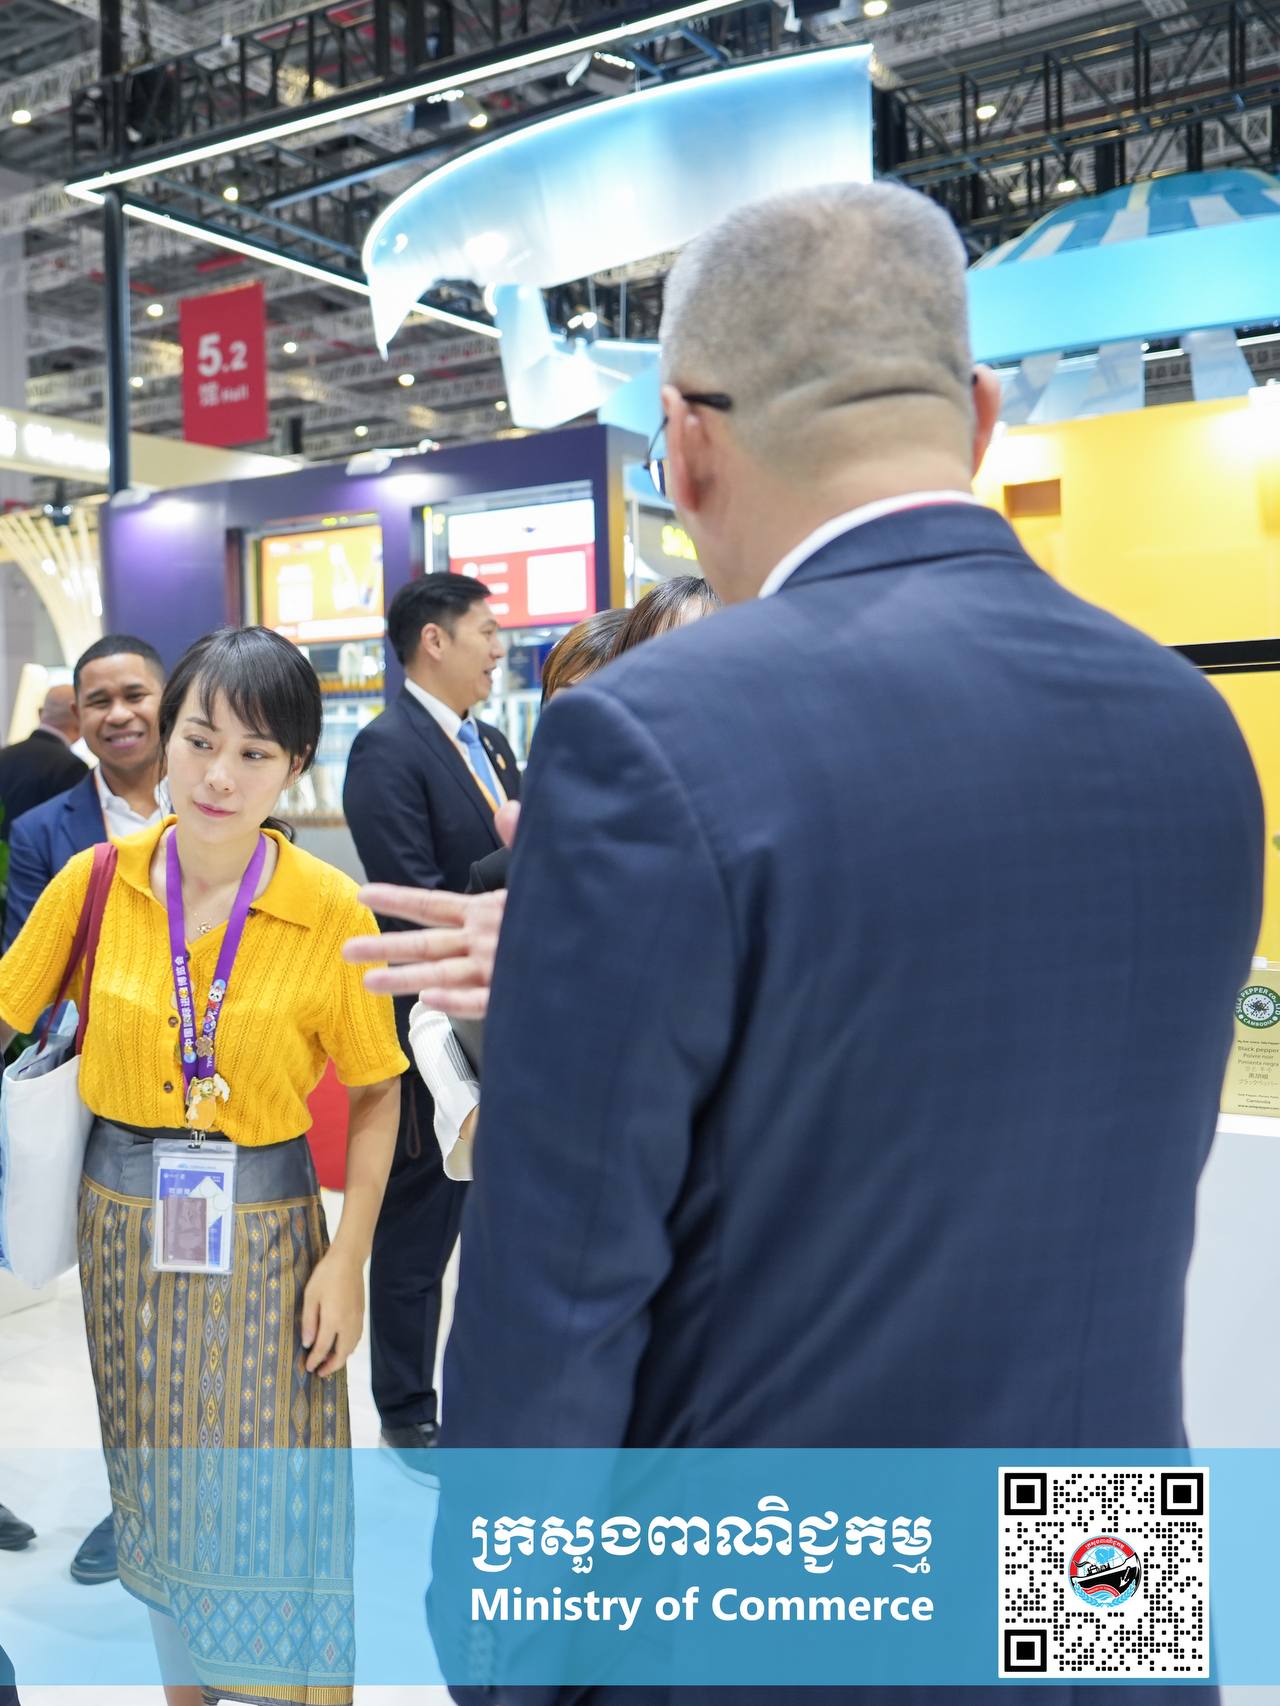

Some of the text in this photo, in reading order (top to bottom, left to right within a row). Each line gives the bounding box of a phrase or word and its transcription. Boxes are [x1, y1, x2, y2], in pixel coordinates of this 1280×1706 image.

[198, 332, 248, 377] 5.2
[1240, 987, 1269, 998] PEPPER
[1243, 1018, 1274, 1027] CAMBODIA
